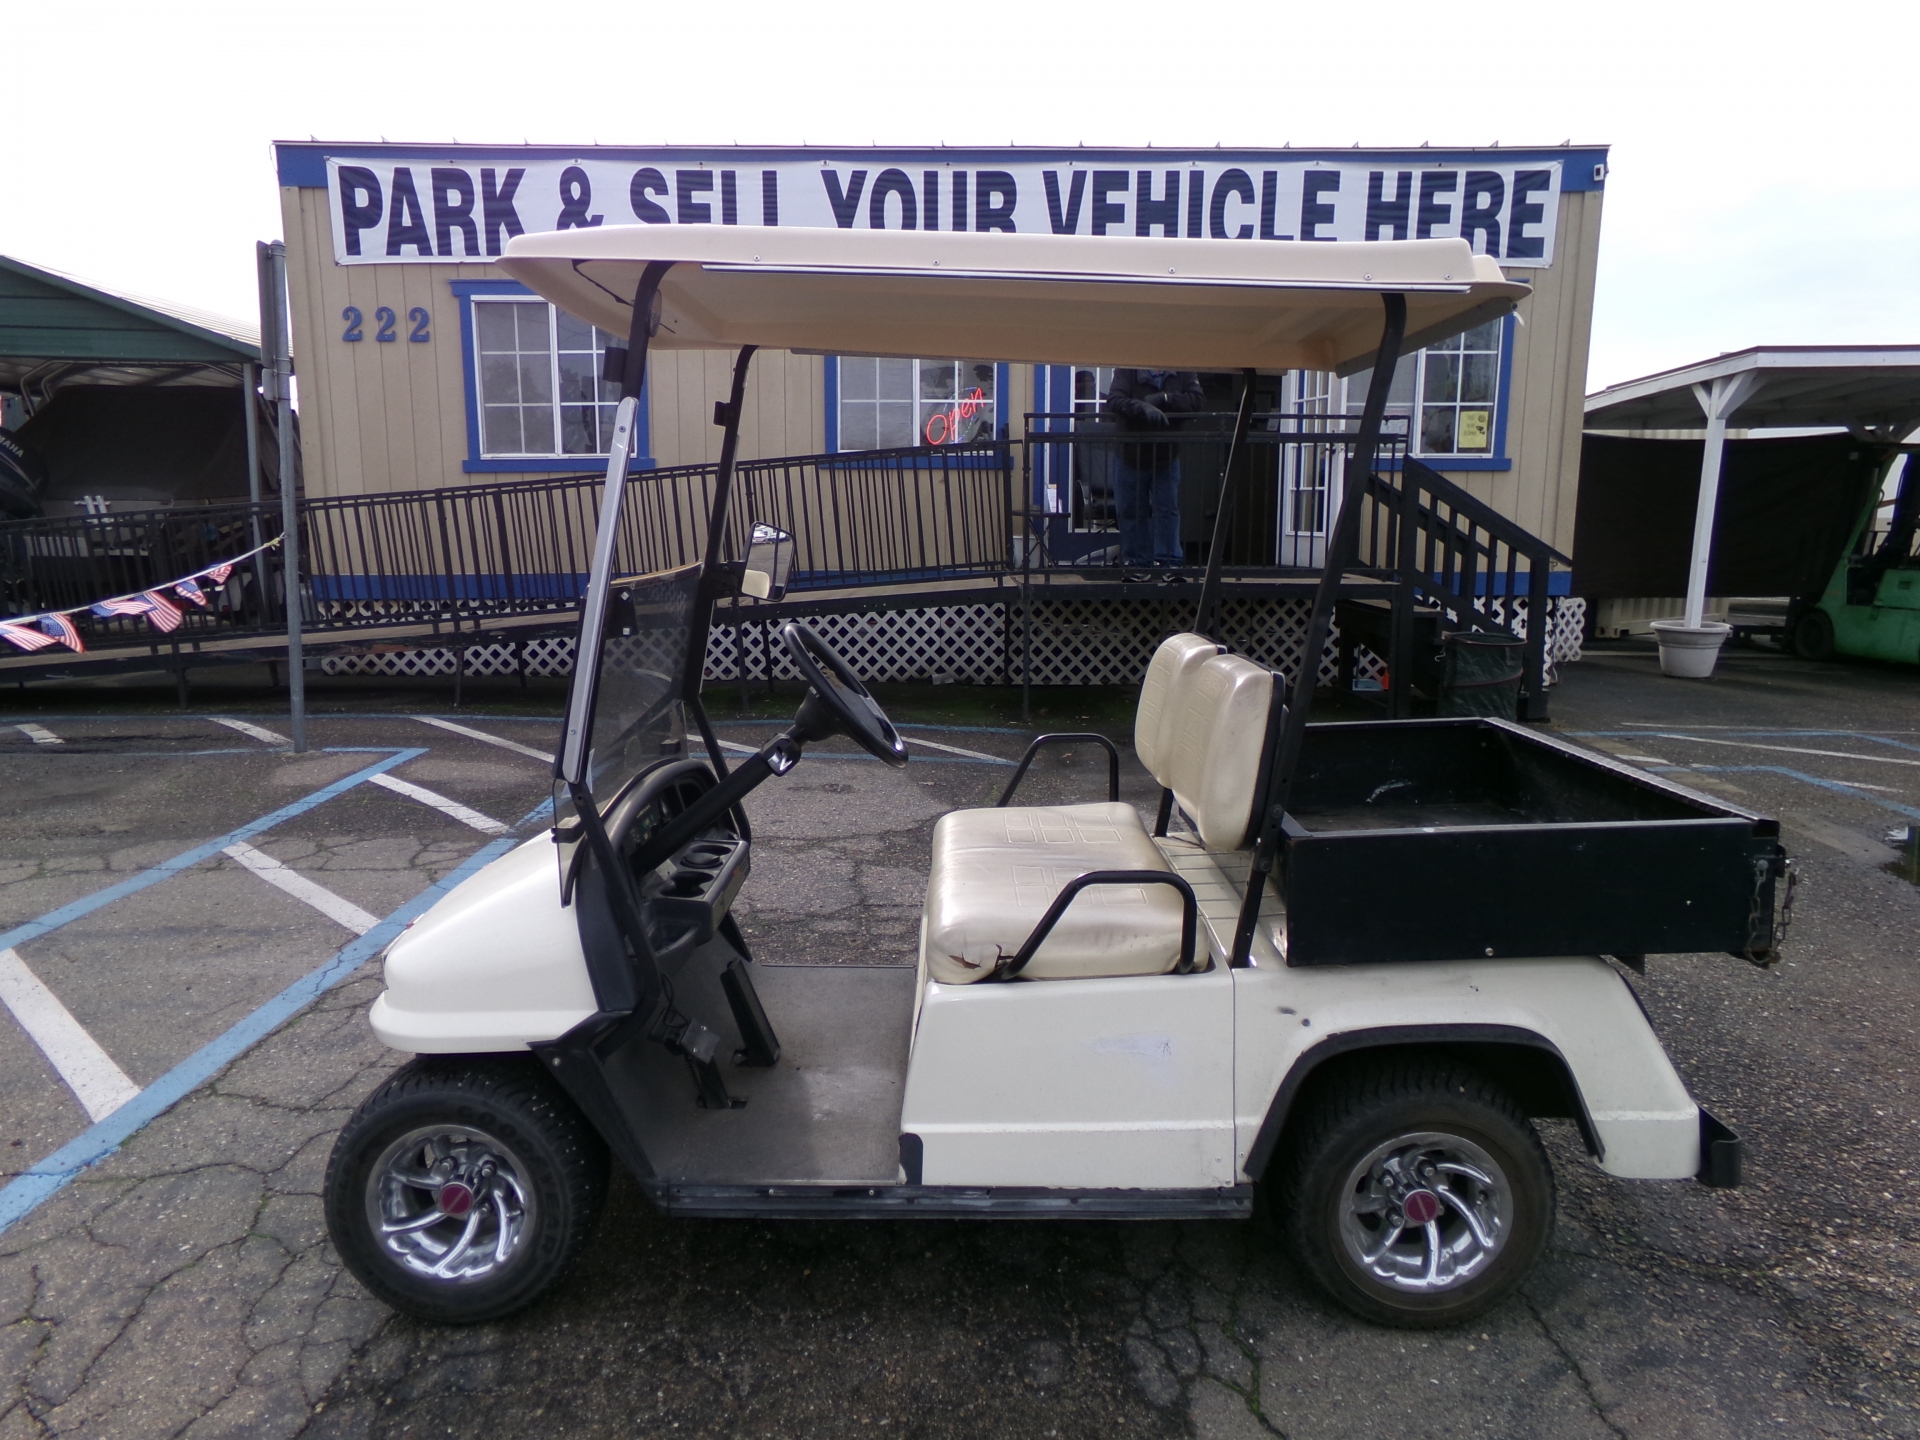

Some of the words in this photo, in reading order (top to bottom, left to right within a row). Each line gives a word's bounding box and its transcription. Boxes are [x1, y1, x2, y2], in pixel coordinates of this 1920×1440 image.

[337, 165, 526, 257] PARK
[556, 166, 604, 231] &
[819, 168, 1018, 234] YOUR
[1042, 168, 1341, 242] VEHICLE
[1364, 169, 1551, 258] HERE
[342, 306, 430, 342] 222
[926, 387, 985, 446] Open
